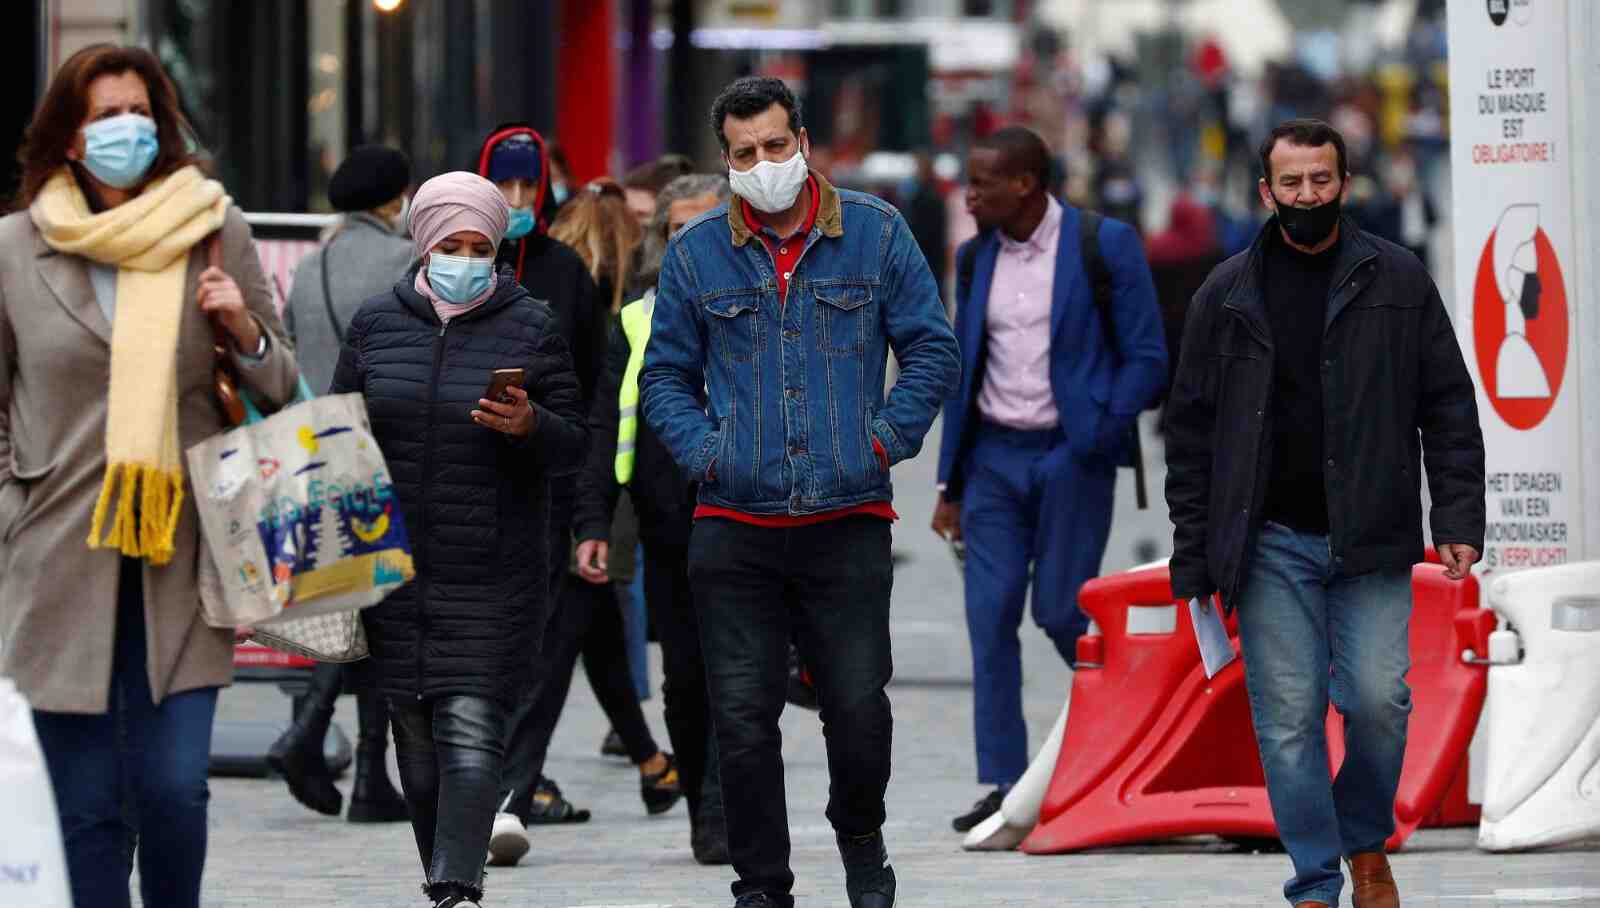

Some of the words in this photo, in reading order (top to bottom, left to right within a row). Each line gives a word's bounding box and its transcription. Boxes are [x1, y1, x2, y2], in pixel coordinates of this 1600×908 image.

[1486, 69, 1502, 89] LE
[1505, 68, 1536, 88] PORT
[1479, 95, 1495, 115] DU
[1499, 92, 1547, 113] MASQUE
[1503, 118, 1524, 138] EST
[1472, 143, 1549, 164] OBLIGATOIRE
[1487, 472, 1510, 492] HET
[1513, 472, 1562, 492] DRAGEN
[1501, 497, 1523, 517] VAN
[1527, 497, 1550, 517] EEN
[1486, 522, 1568, 542] MONDMASKER
